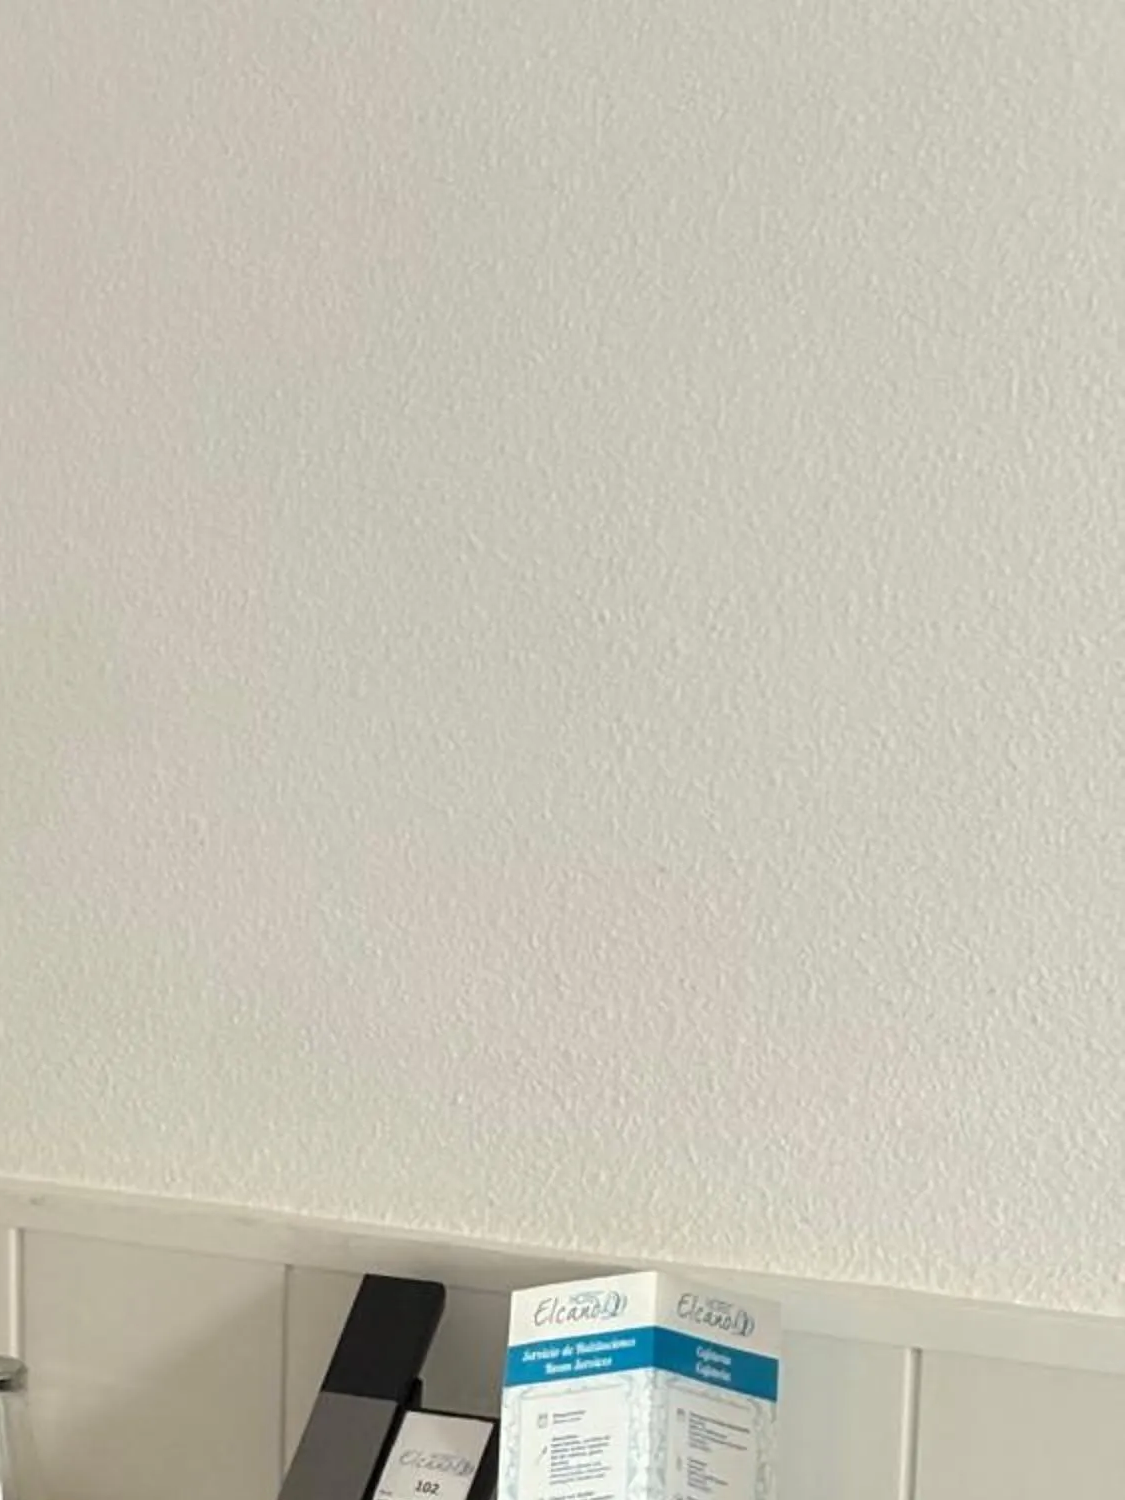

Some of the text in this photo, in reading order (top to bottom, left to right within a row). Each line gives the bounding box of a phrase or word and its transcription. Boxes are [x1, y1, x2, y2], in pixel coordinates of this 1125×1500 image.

[534, 1295, 601, 1327] Elcano
[677, 1292, 732, 1331] Elcano
[415, 1480, 440, 1496] 102
